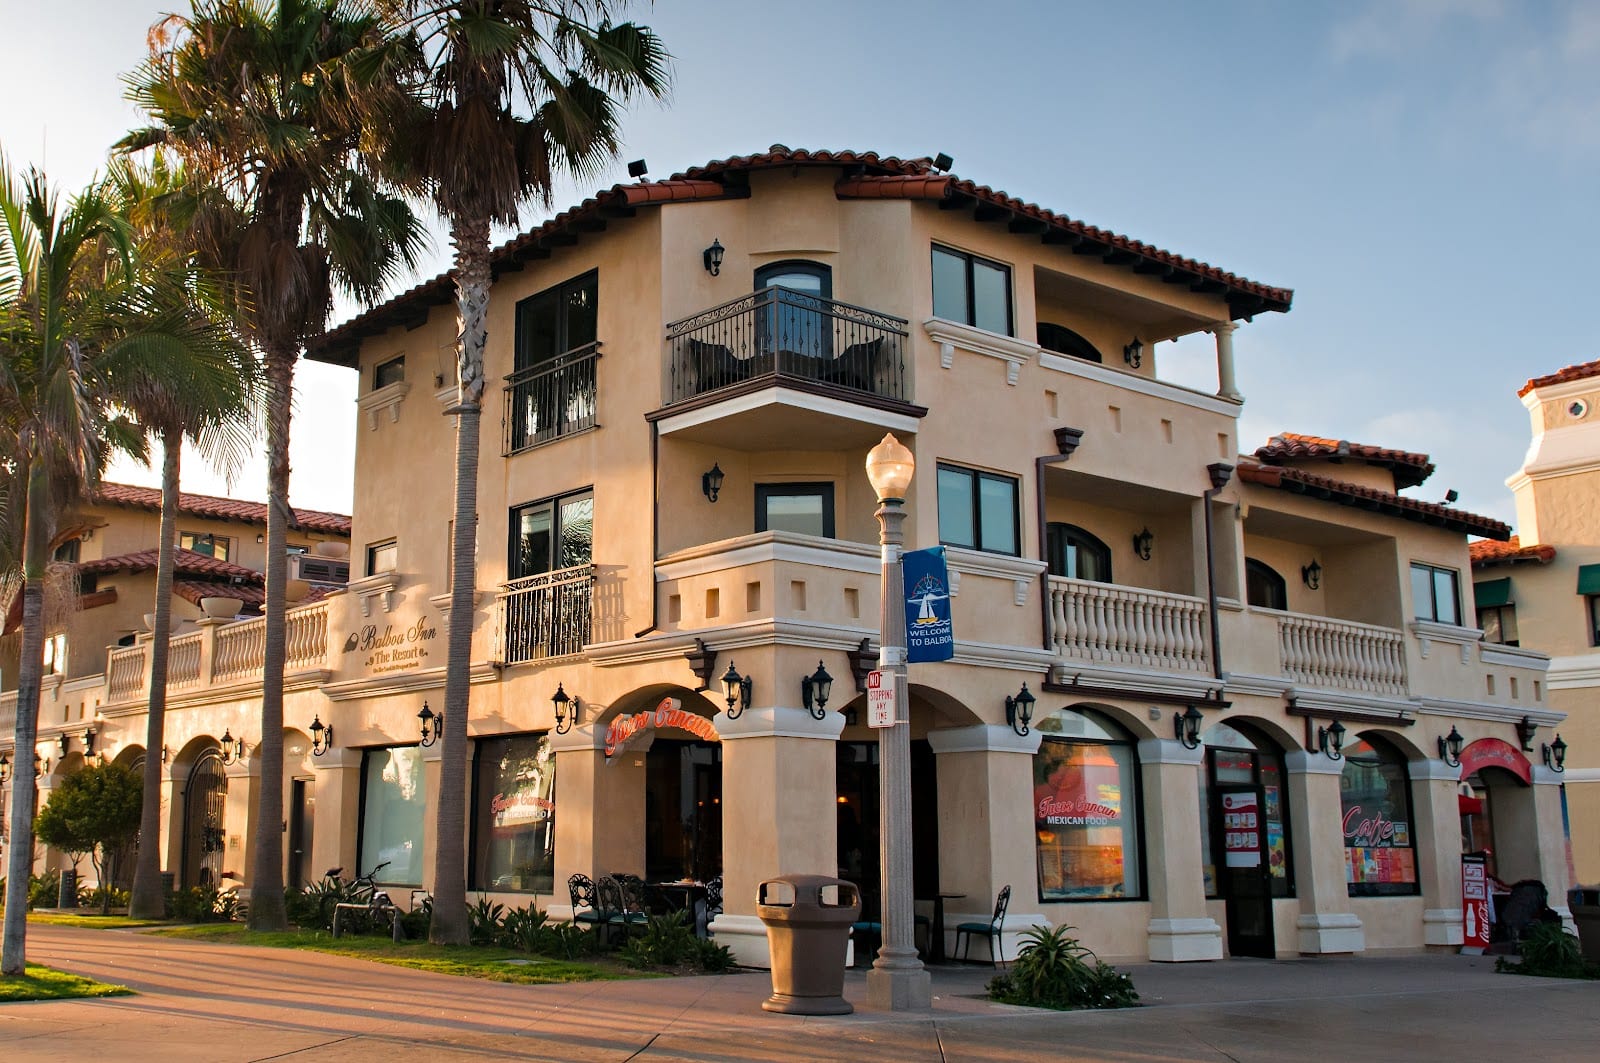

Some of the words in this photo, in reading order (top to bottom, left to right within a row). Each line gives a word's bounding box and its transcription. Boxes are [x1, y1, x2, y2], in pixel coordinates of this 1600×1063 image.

[360, 625, 404, 651] Balboa
[407, 616, 436, 642] Inn
[910, 627, 950, 636] WELCOME
[911, 638, 922, 646] TO
[924, 635, 952, 646] BALBOA
[375, 651, 390, 665] The
[393, 647, 418, 661] Resort
[869, 673, 879, 687] NO
[870, 690, 893, 701] STOPPING
[876, 702, 886, 710] ANY
[654, 696, 720, 742] Cancun
[875, 711, 888, 721] TIME
[1039, 796, 1074, 818] Tacos
[1075, 796, 1118, 818] Cancun
[1047, 815, 1084, 825] MEXICAN
[1085, 816, 1108, 825] FOOD
